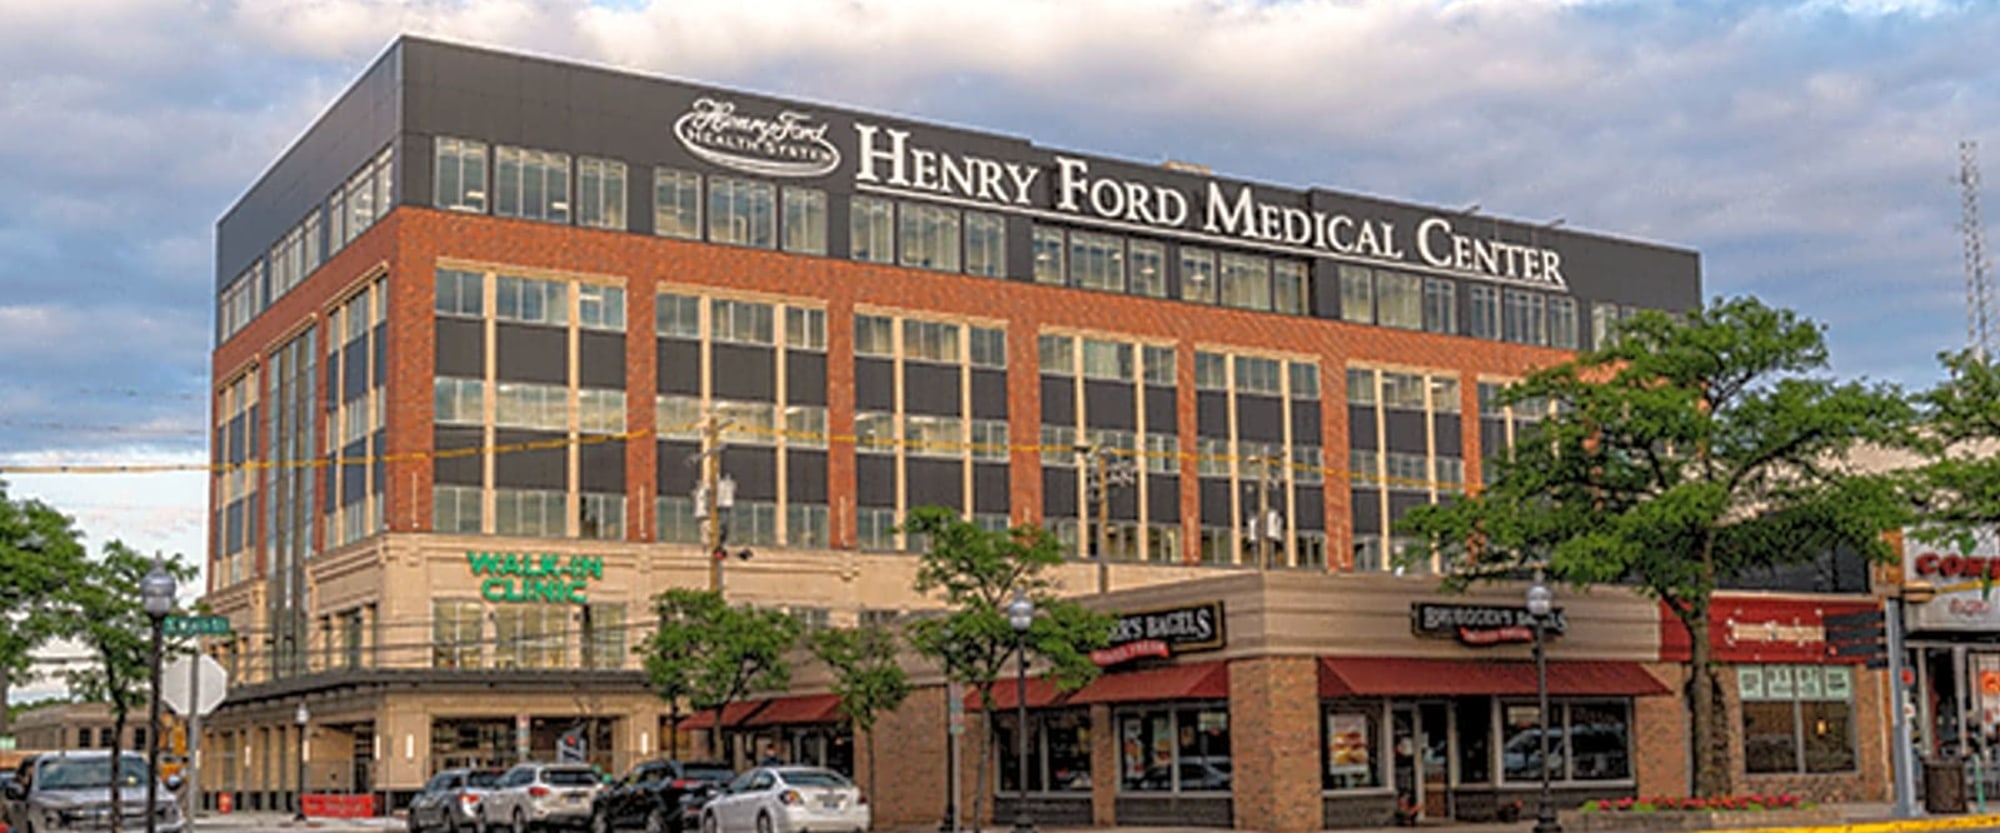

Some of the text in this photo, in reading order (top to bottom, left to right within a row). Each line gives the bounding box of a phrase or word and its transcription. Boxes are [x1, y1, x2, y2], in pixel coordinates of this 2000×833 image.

[854, 122, 1565, 286] HENRY FORD MEDICAL CENTER
[466, 551, 602, 580] WALK-IN
[482, 577, 587, 603] CLINIC
[1147, 608, 1212, 639] BAGELS
